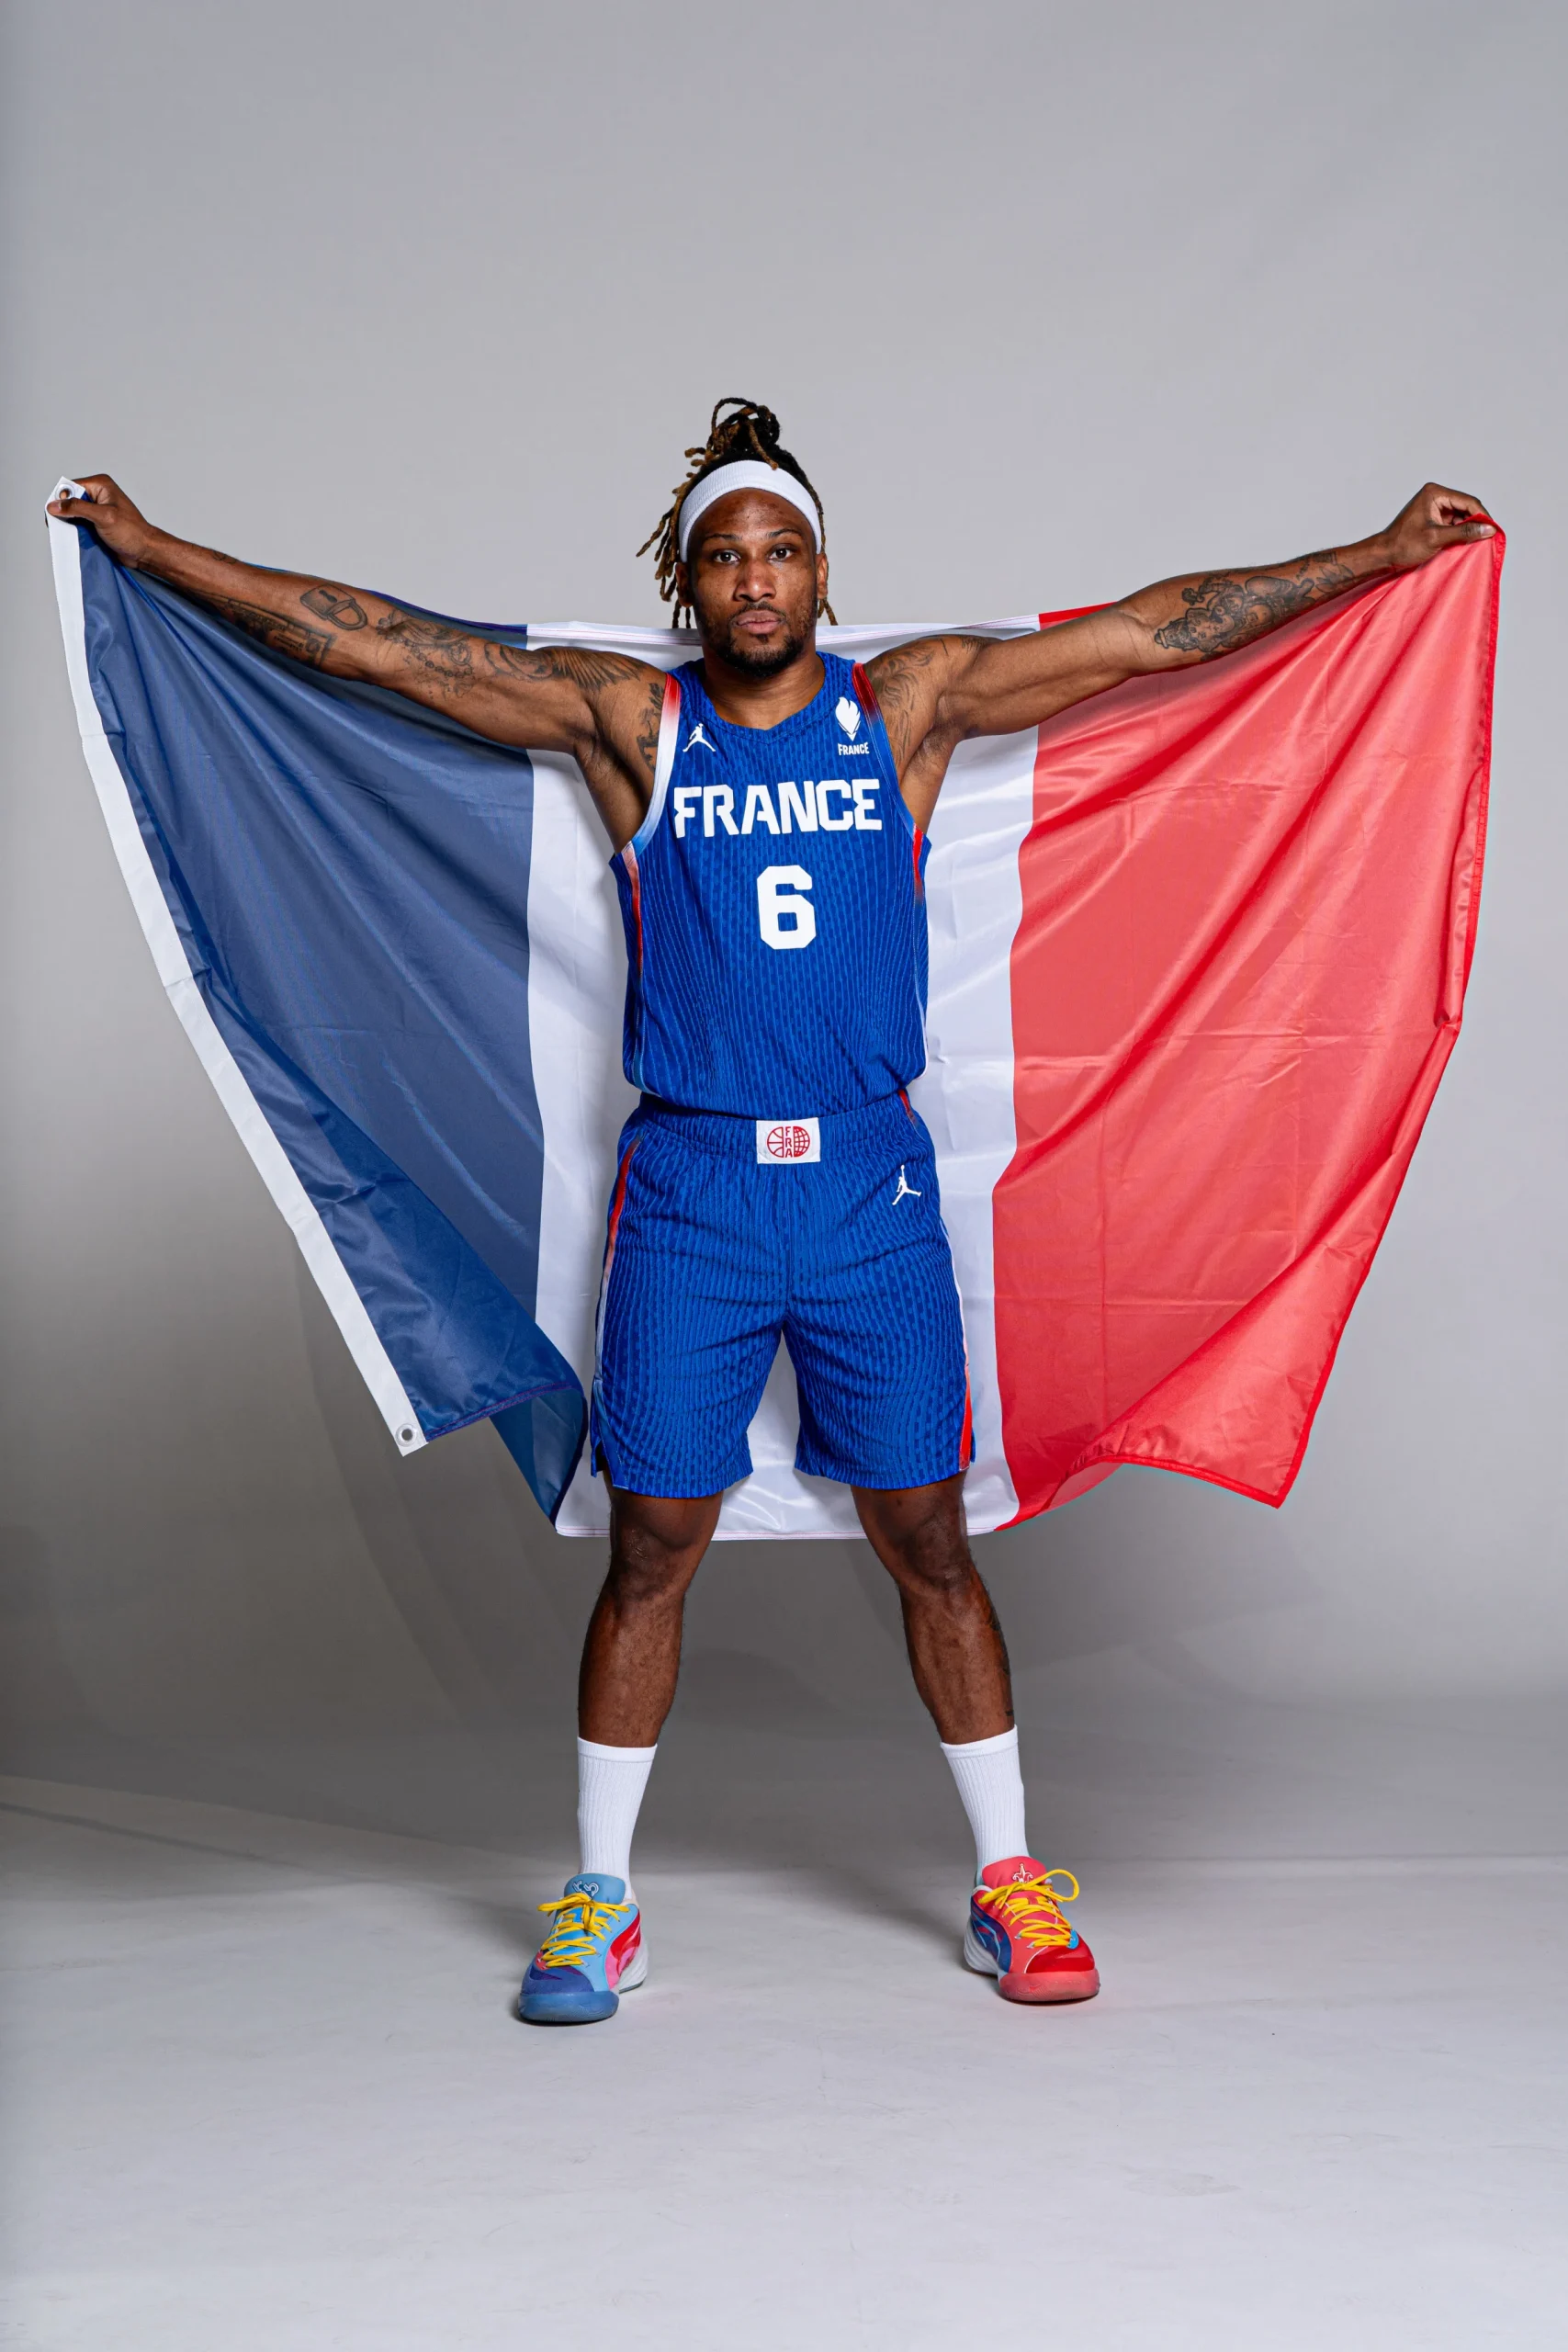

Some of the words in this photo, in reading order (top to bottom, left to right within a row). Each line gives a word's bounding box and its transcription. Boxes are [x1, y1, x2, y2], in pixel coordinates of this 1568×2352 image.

[838, 741, 870, 755] FRANCE
[673, 779, 882, 838] FRANCE
[756, 865, 817, 950] 6
[784, 1126, 793, 1158] FRA
